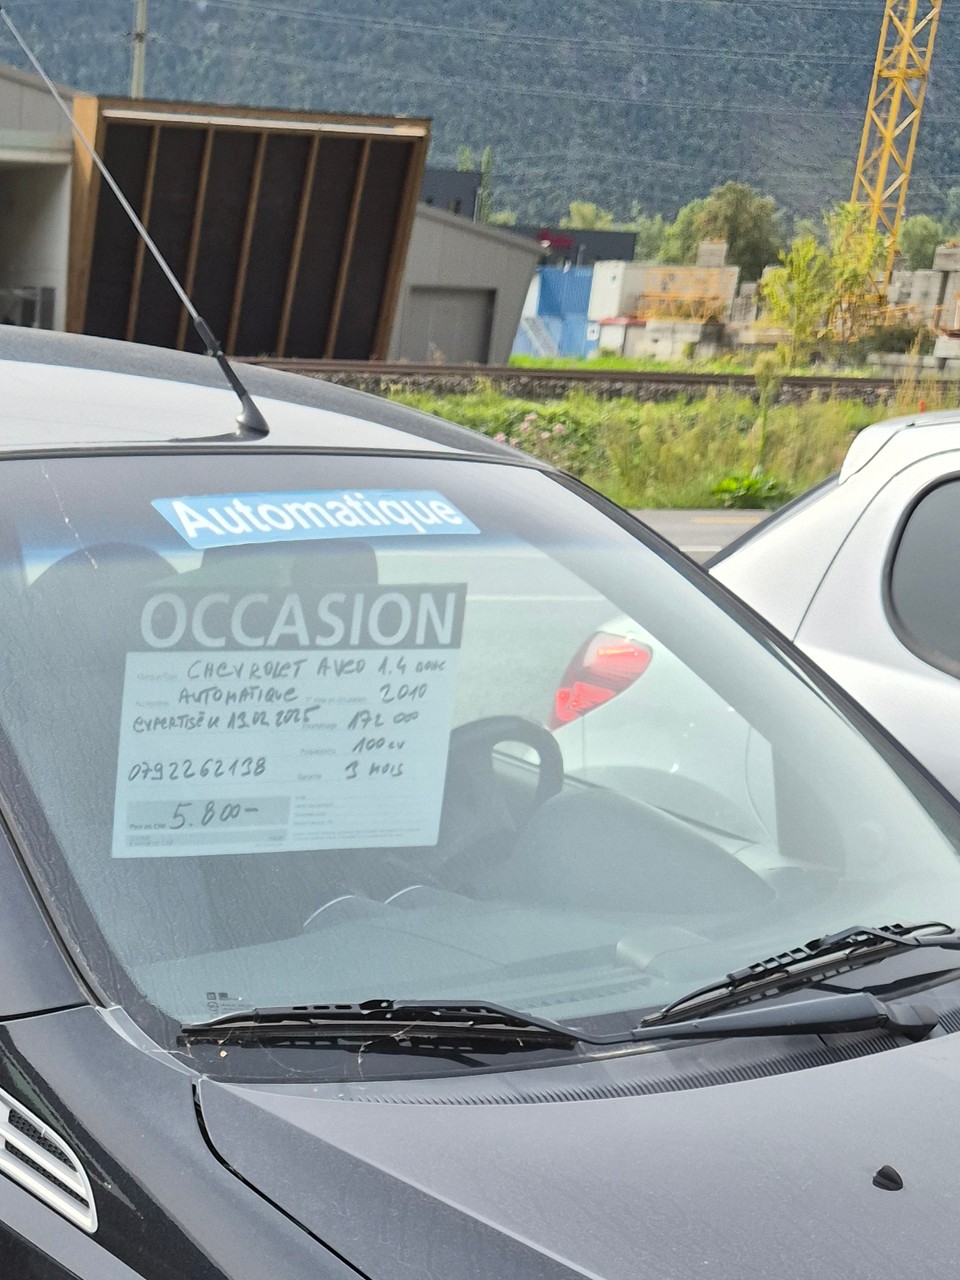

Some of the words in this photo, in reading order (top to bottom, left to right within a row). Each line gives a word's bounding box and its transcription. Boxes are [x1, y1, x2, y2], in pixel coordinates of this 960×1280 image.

[172, 493, 463, 539] Automatique
[140, 592, 457, 649] OCCASION
[187, 659, 308, 680] CHEVROLET
[378, 656, 407, 675] 1.4
[178, 686, 299, 706] AUTOMATIQUE
[379, 683, 428, 703] 2010
[345, 760, 359, 780] 3
